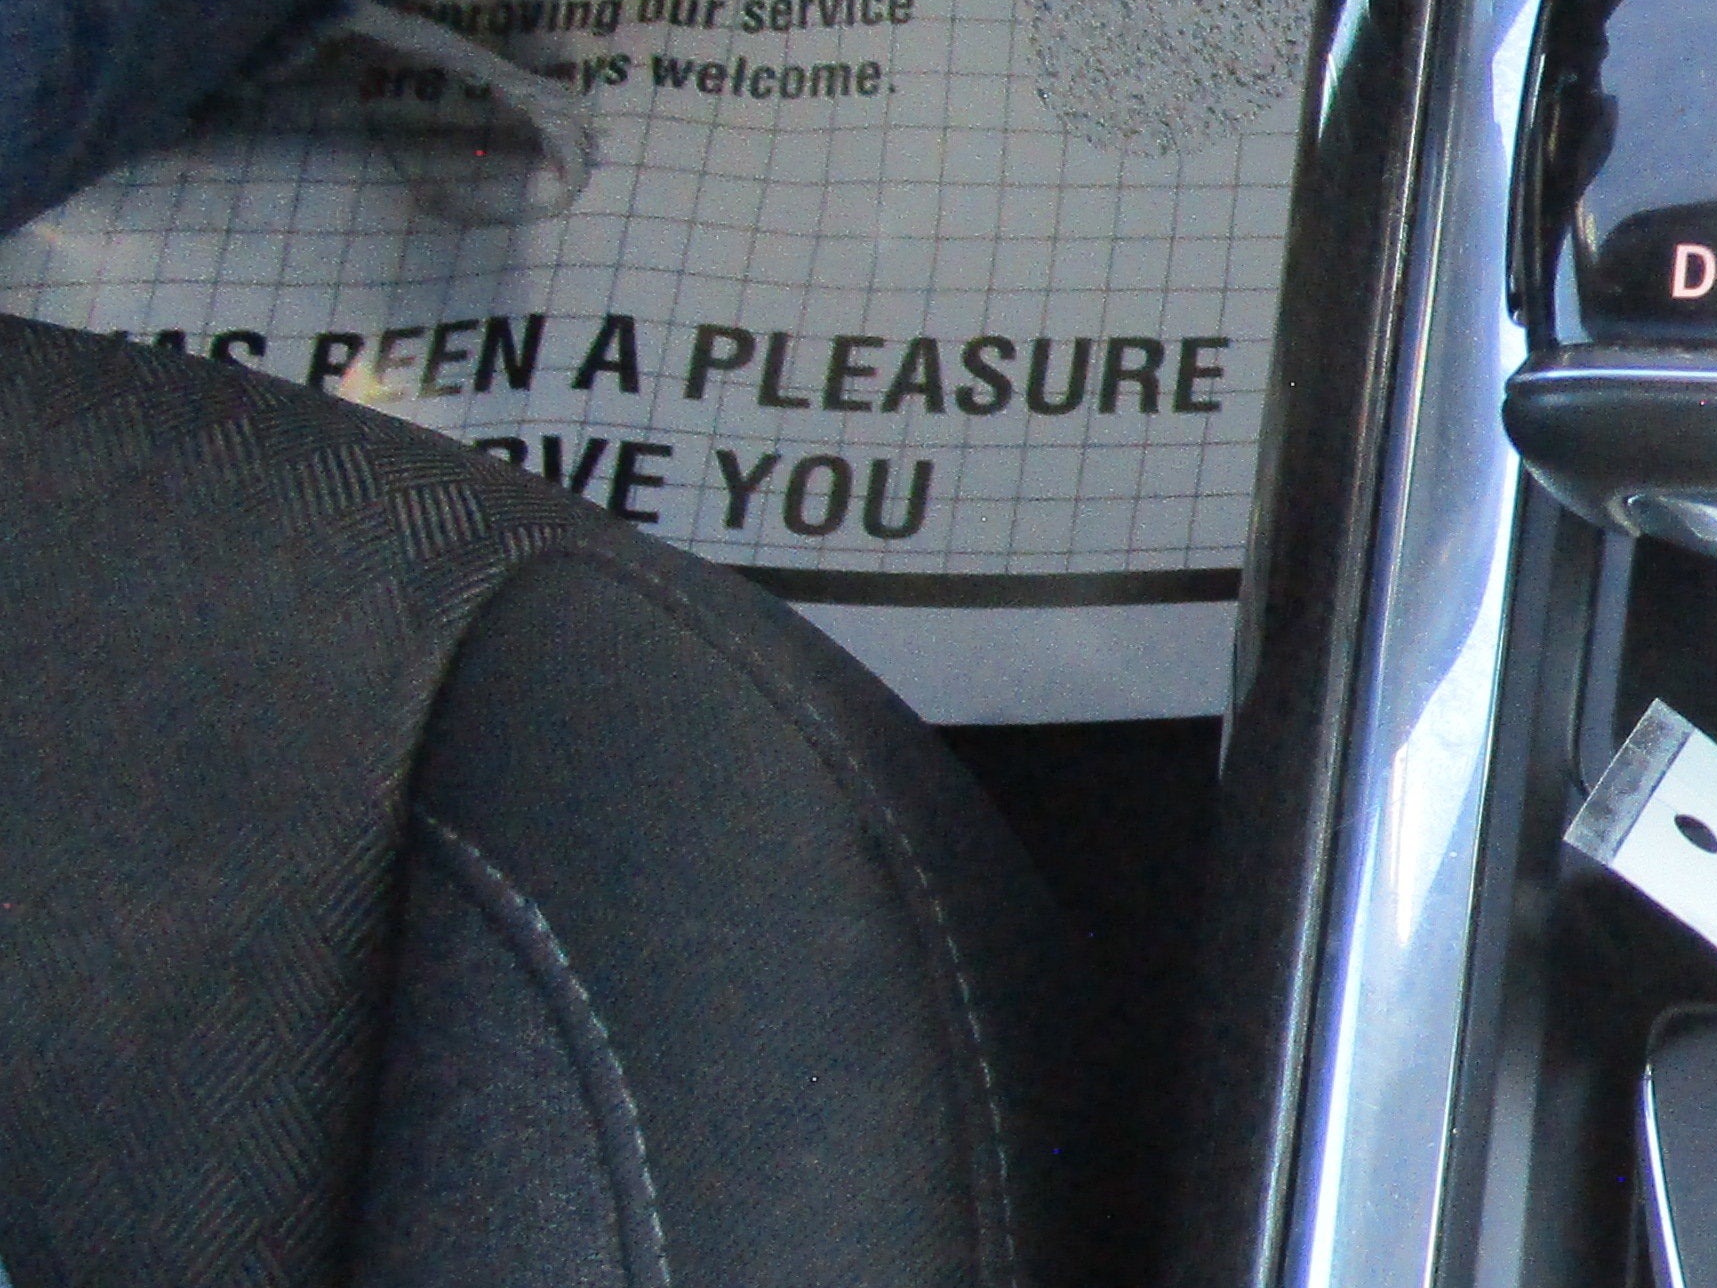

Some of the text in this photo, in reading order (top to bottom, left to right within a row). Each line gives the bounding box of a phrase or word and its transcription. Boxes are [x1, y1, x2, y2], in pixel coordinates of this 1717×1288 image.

[650, 54, 896, 101] welcome.
[570, 313, 641, 394] A
[683, 324, 1232, 416] PLEASURE
[714, 448, 935, 541] YOU
